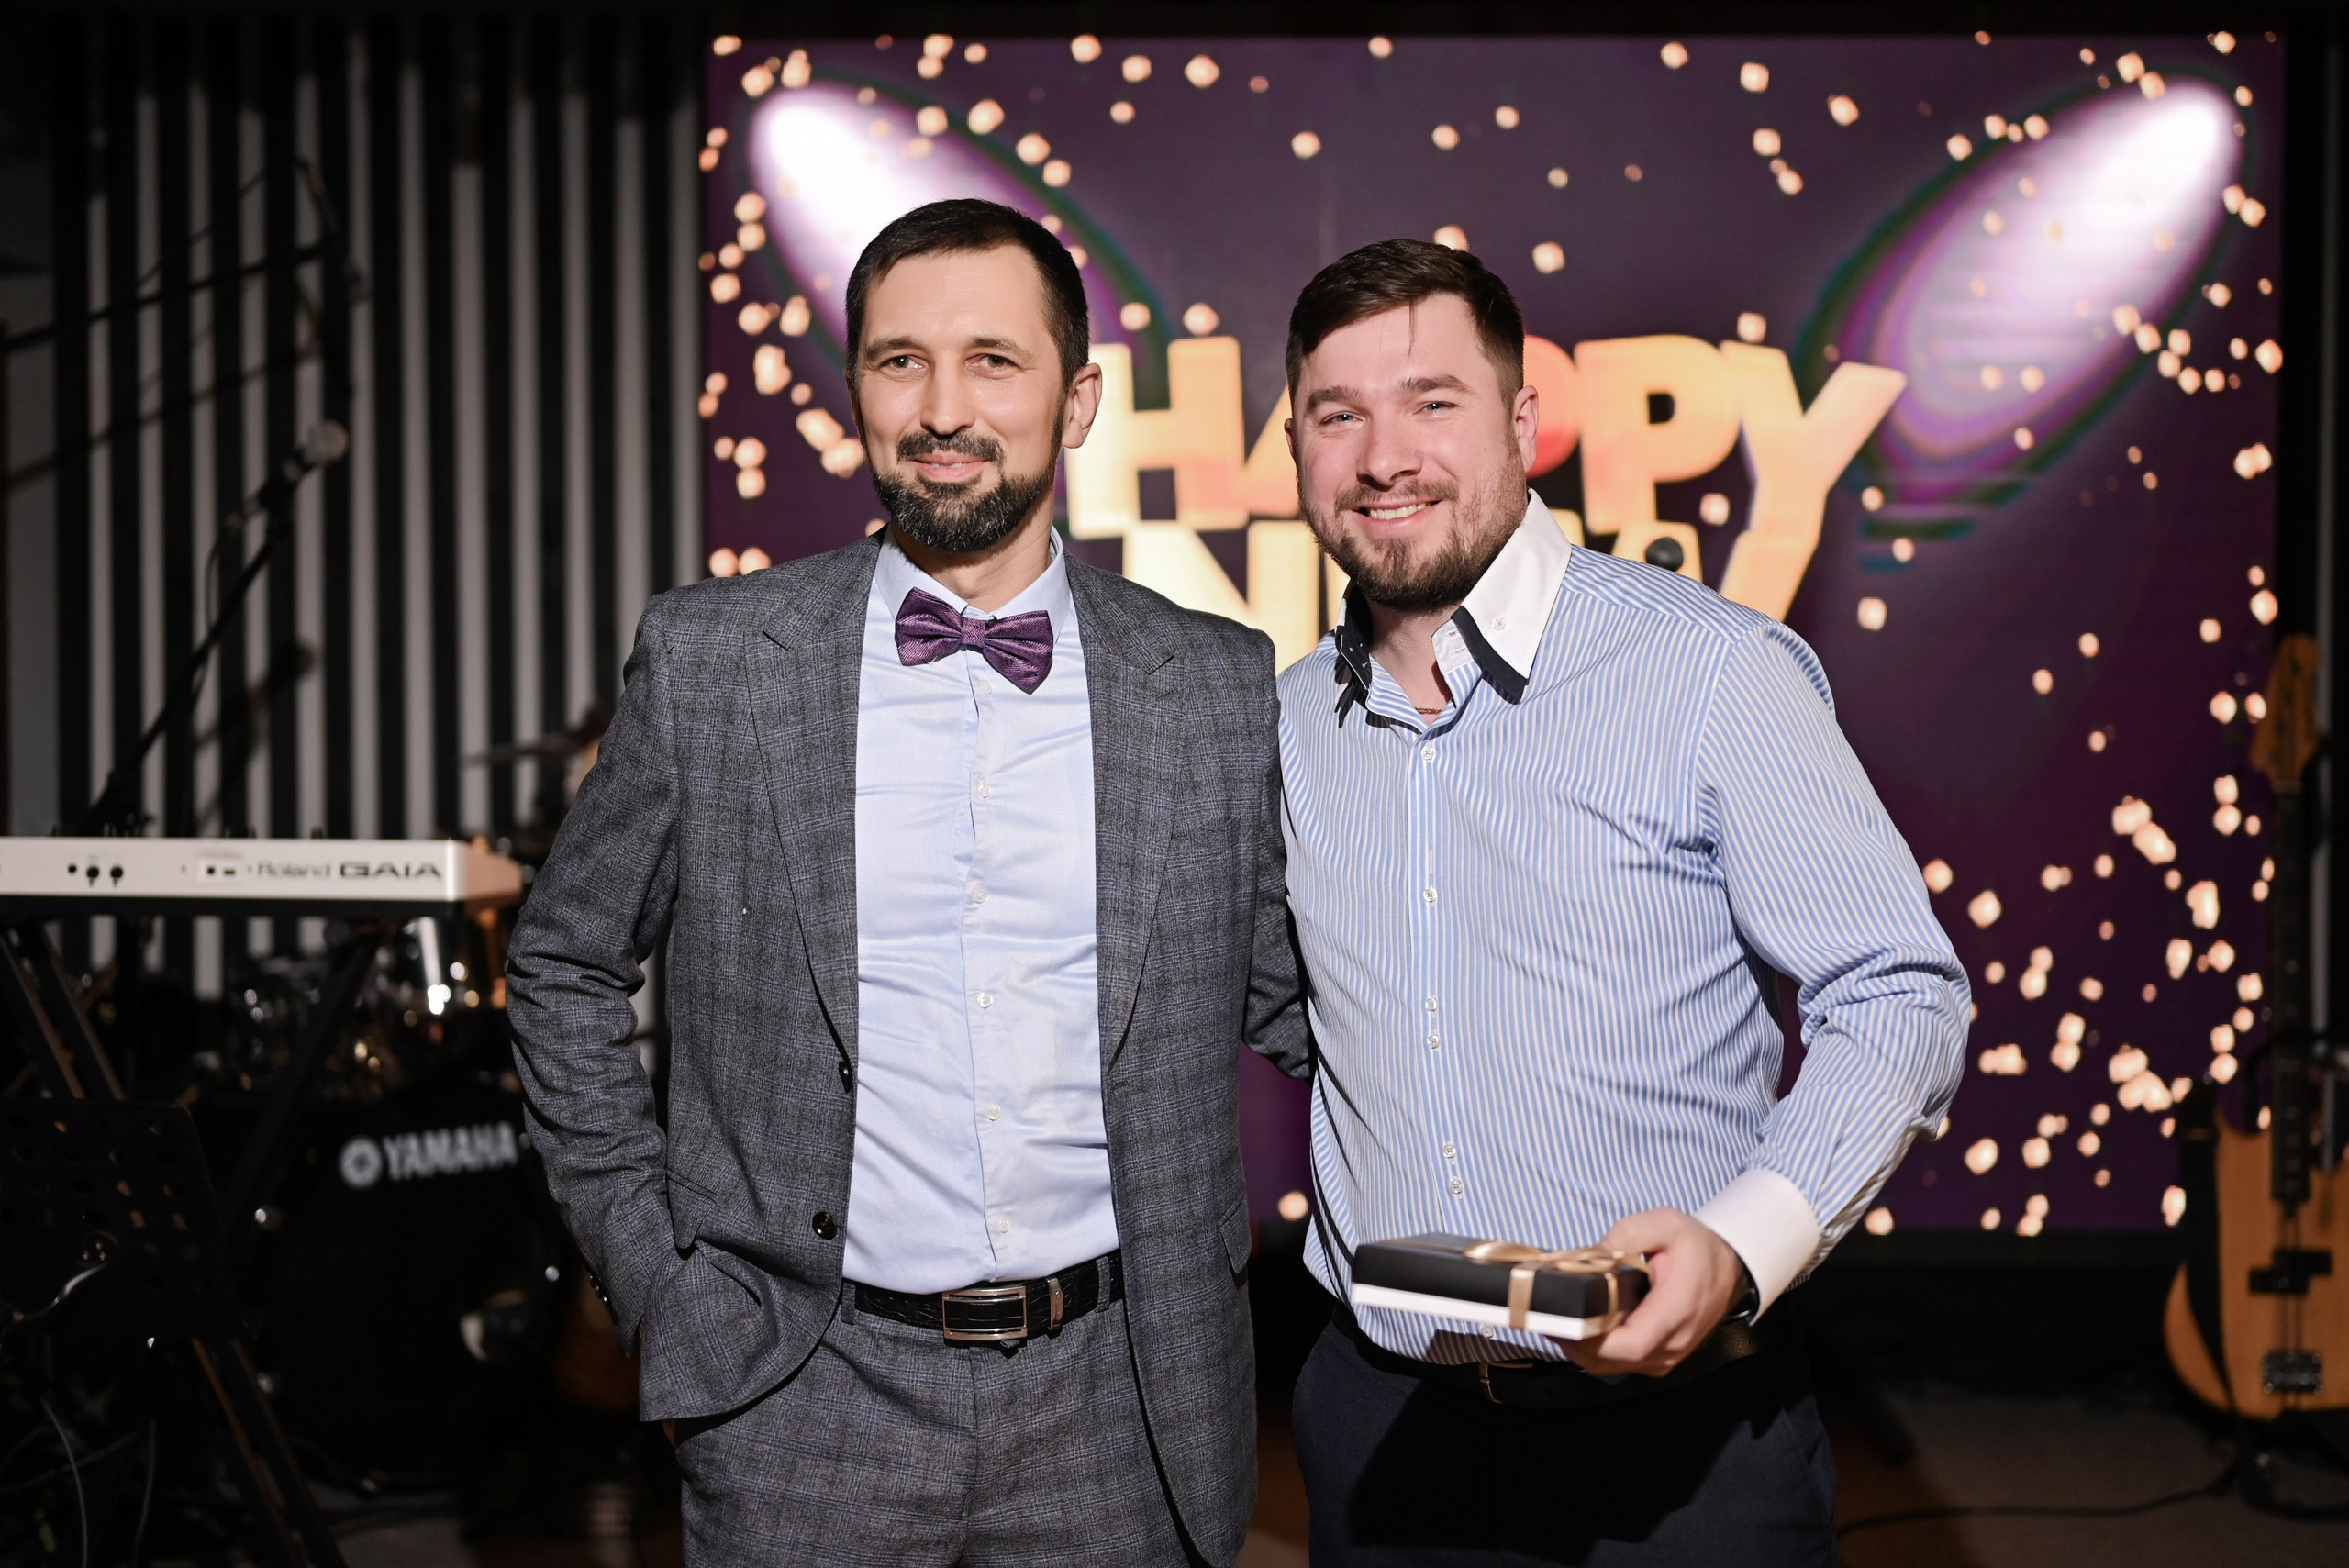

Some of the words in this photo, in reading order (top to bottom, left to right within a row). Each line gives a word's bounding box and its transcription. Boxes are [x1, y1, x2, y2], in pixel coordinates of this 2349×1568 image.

[1066, 334, 1907, 540] HPY
[258, 861, 330, 878] Roland
[340, 862, 441, 879] GAIA
[383, 1121, 518, 1180] YAMAHA
